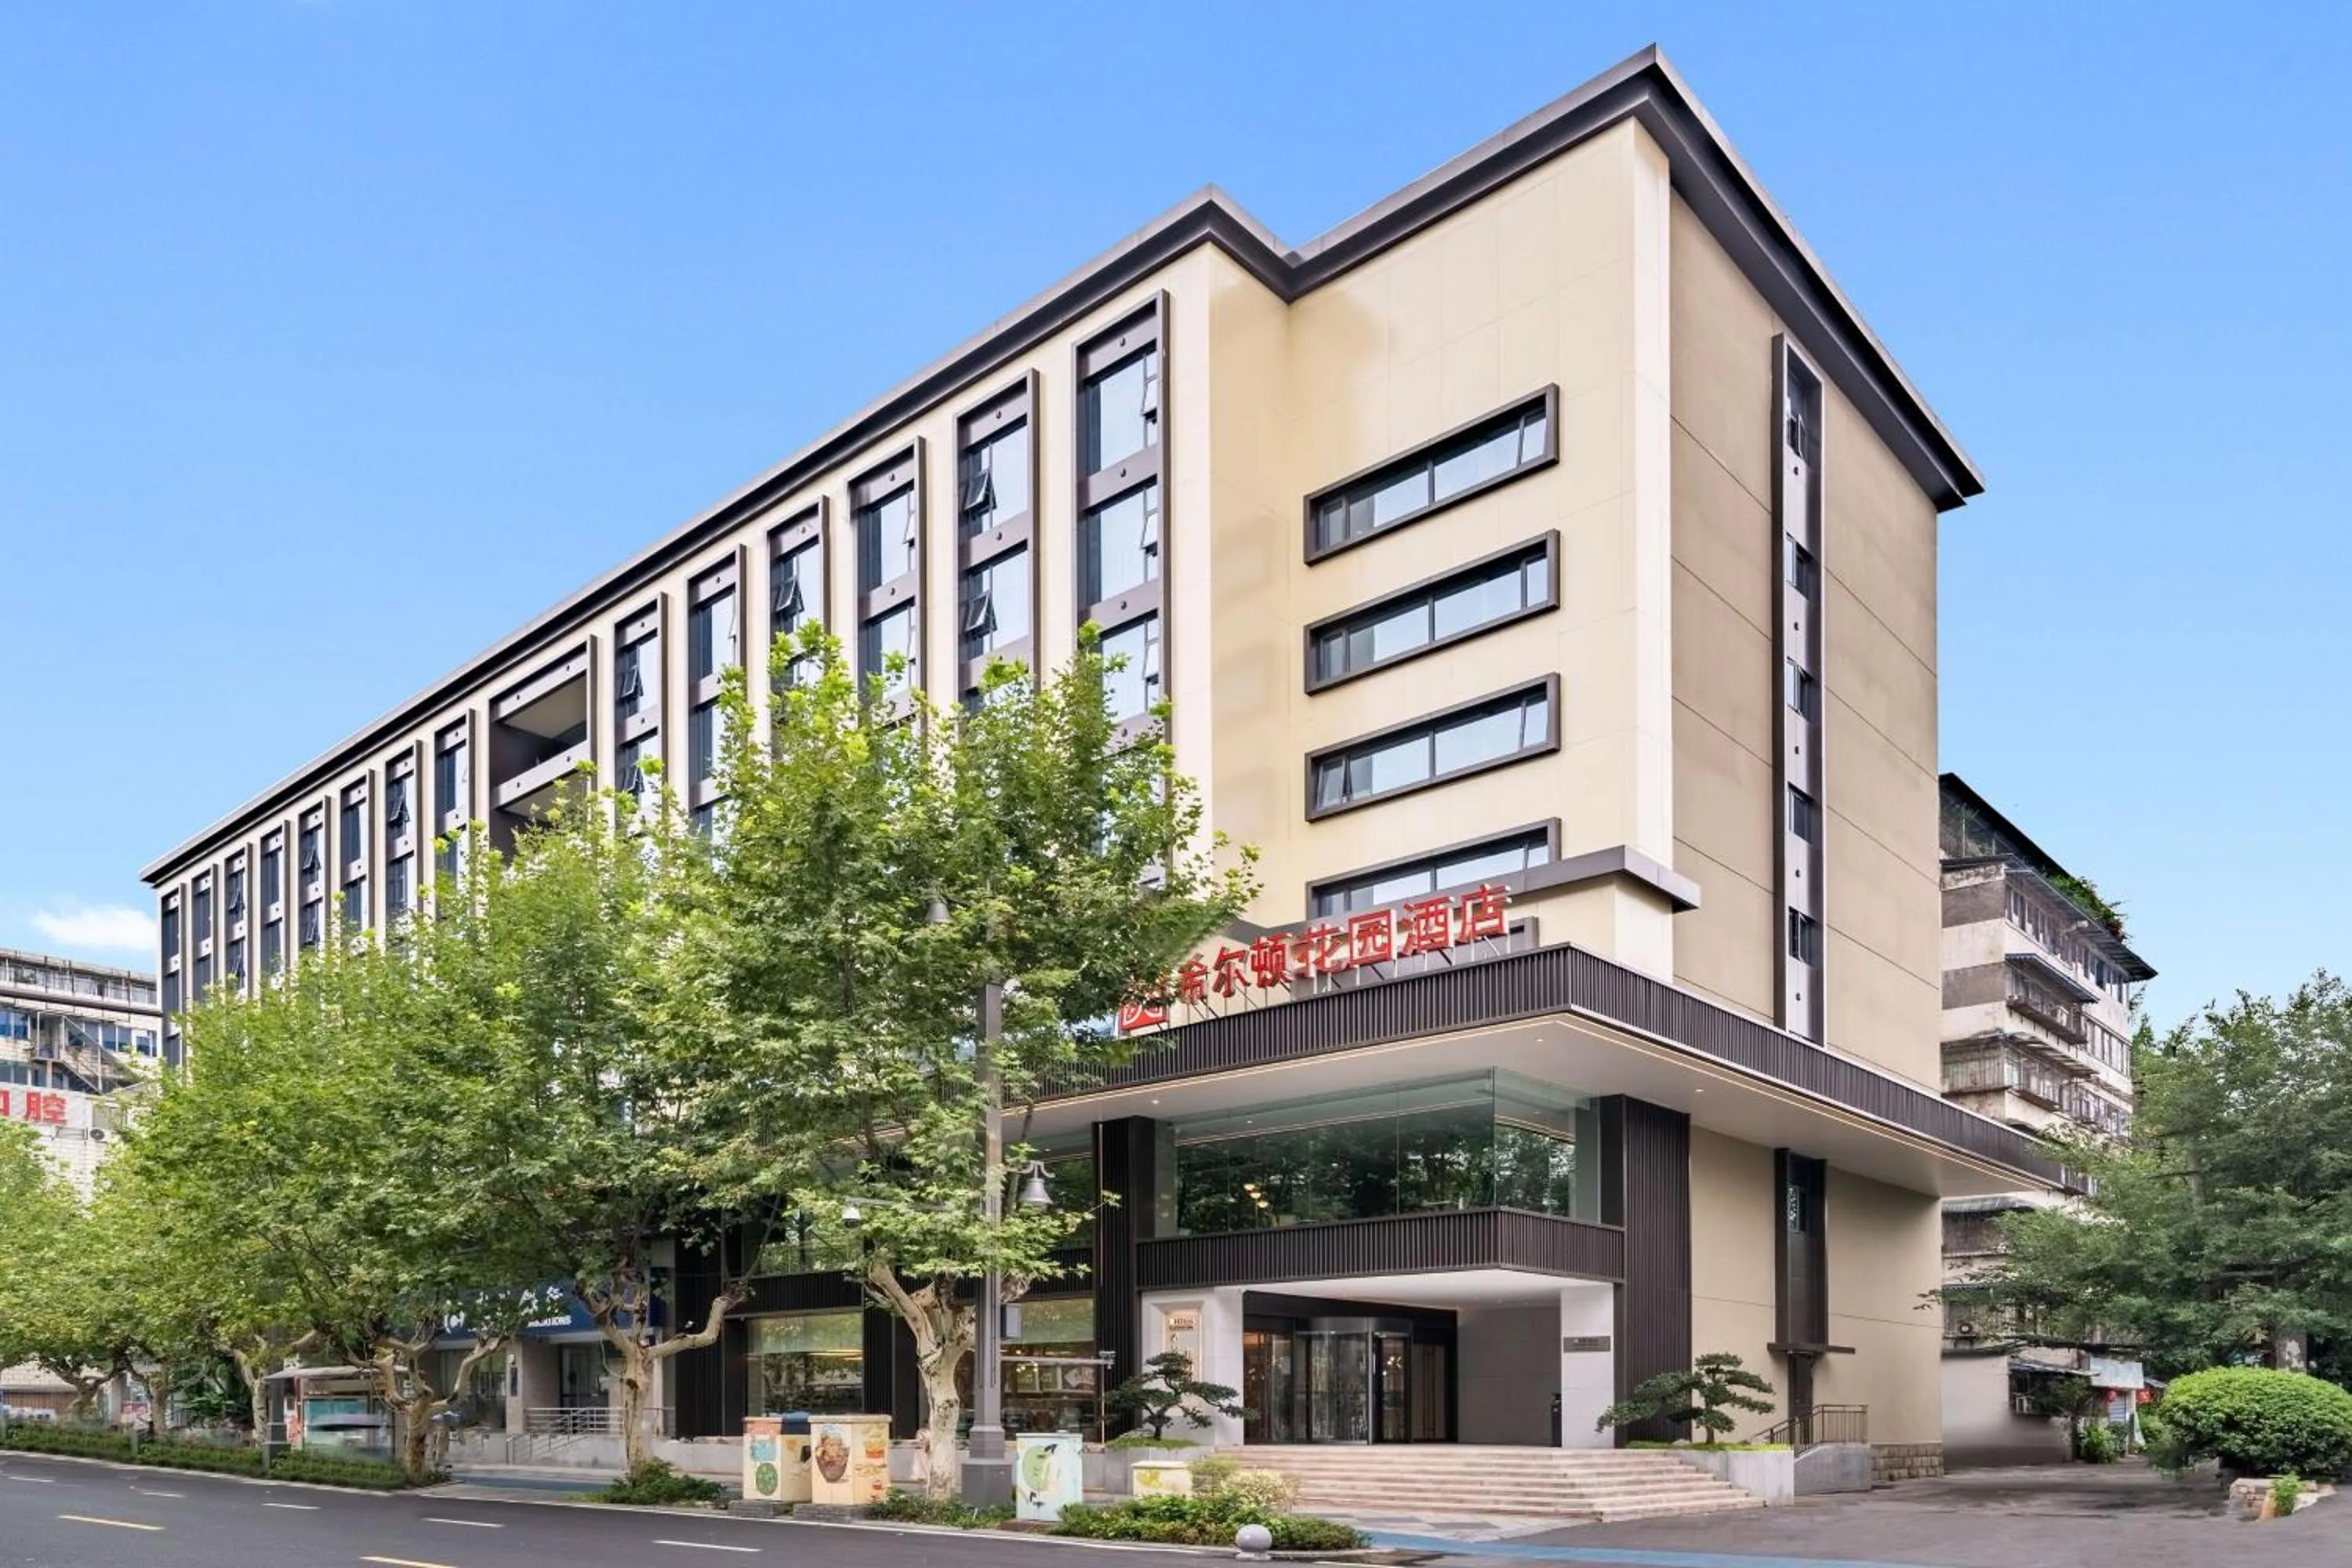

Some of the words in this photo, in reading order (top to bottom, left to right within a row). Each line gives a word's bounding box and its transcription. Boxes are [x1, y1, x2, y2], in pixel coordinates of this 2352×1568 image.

[1178, 883, 1510, 1004] 希尔顿花园酒店
